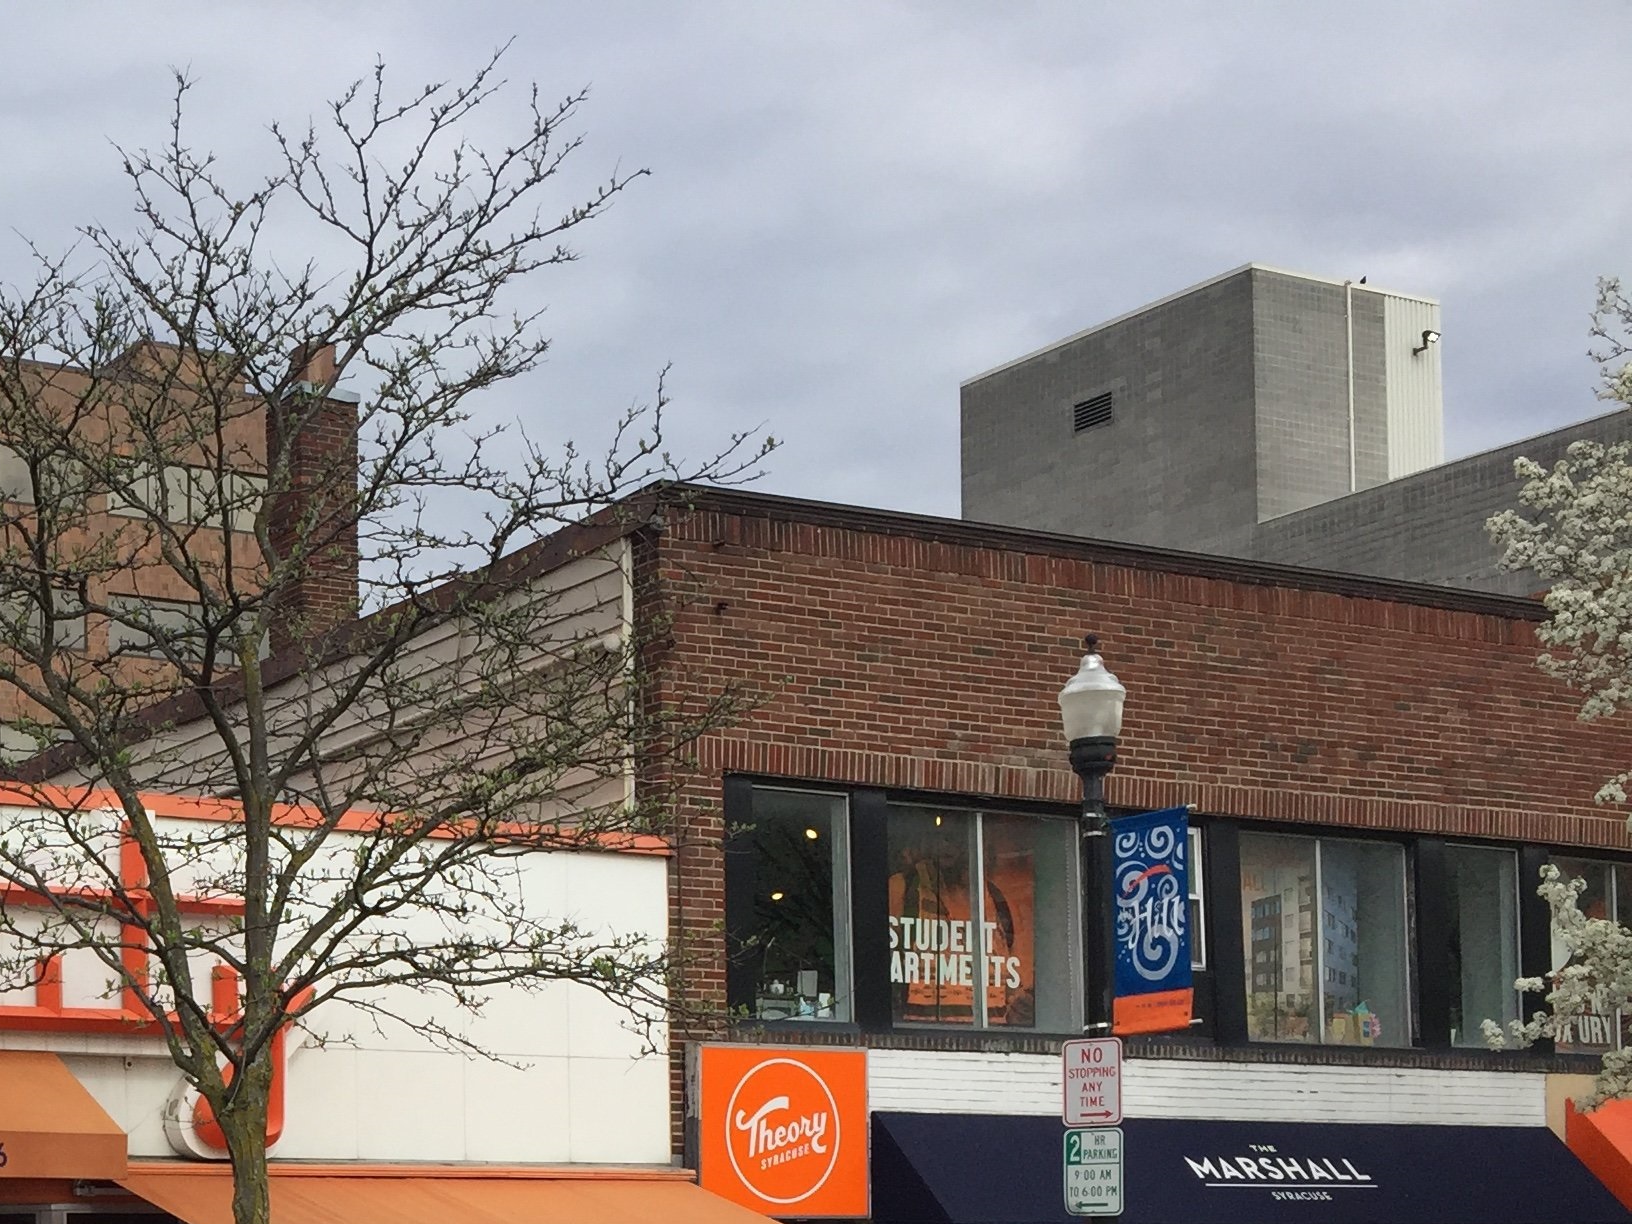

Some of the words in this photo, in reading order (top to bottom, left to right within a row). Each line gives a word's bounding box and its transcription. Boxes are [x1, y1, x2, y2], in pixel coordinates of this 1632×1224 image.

[889, 916, 997, 954] STUDET
[1081, 1047, 1103, 1063] NO
[1068, 1066, 1116, 1080] STOPPING
[1081, 1081, 1103, 1093] ANY
[1080, 1096, 1105, 1107] TIME
[735, 1096, 827, 1158] Theory
[1069, 1134, 1081, 1162] 2
[1094, 1135, 1106, 1146] HR
[1083, 1147, 1118, 1160] PARKING
[1249, 1144, 1278, 1153] THE
[760, 1143, 810, 1171] SYRACUSE
[1099, 1169, 1112, 1180] AM
[1183, 1155, 1372, 1181] MARSHALL
[1069, 1186, 1079, 1198] TO
[1105, 1185, 1118, 1197] PM
[1271, 1191, 1333, 1201] SYRACUSE
